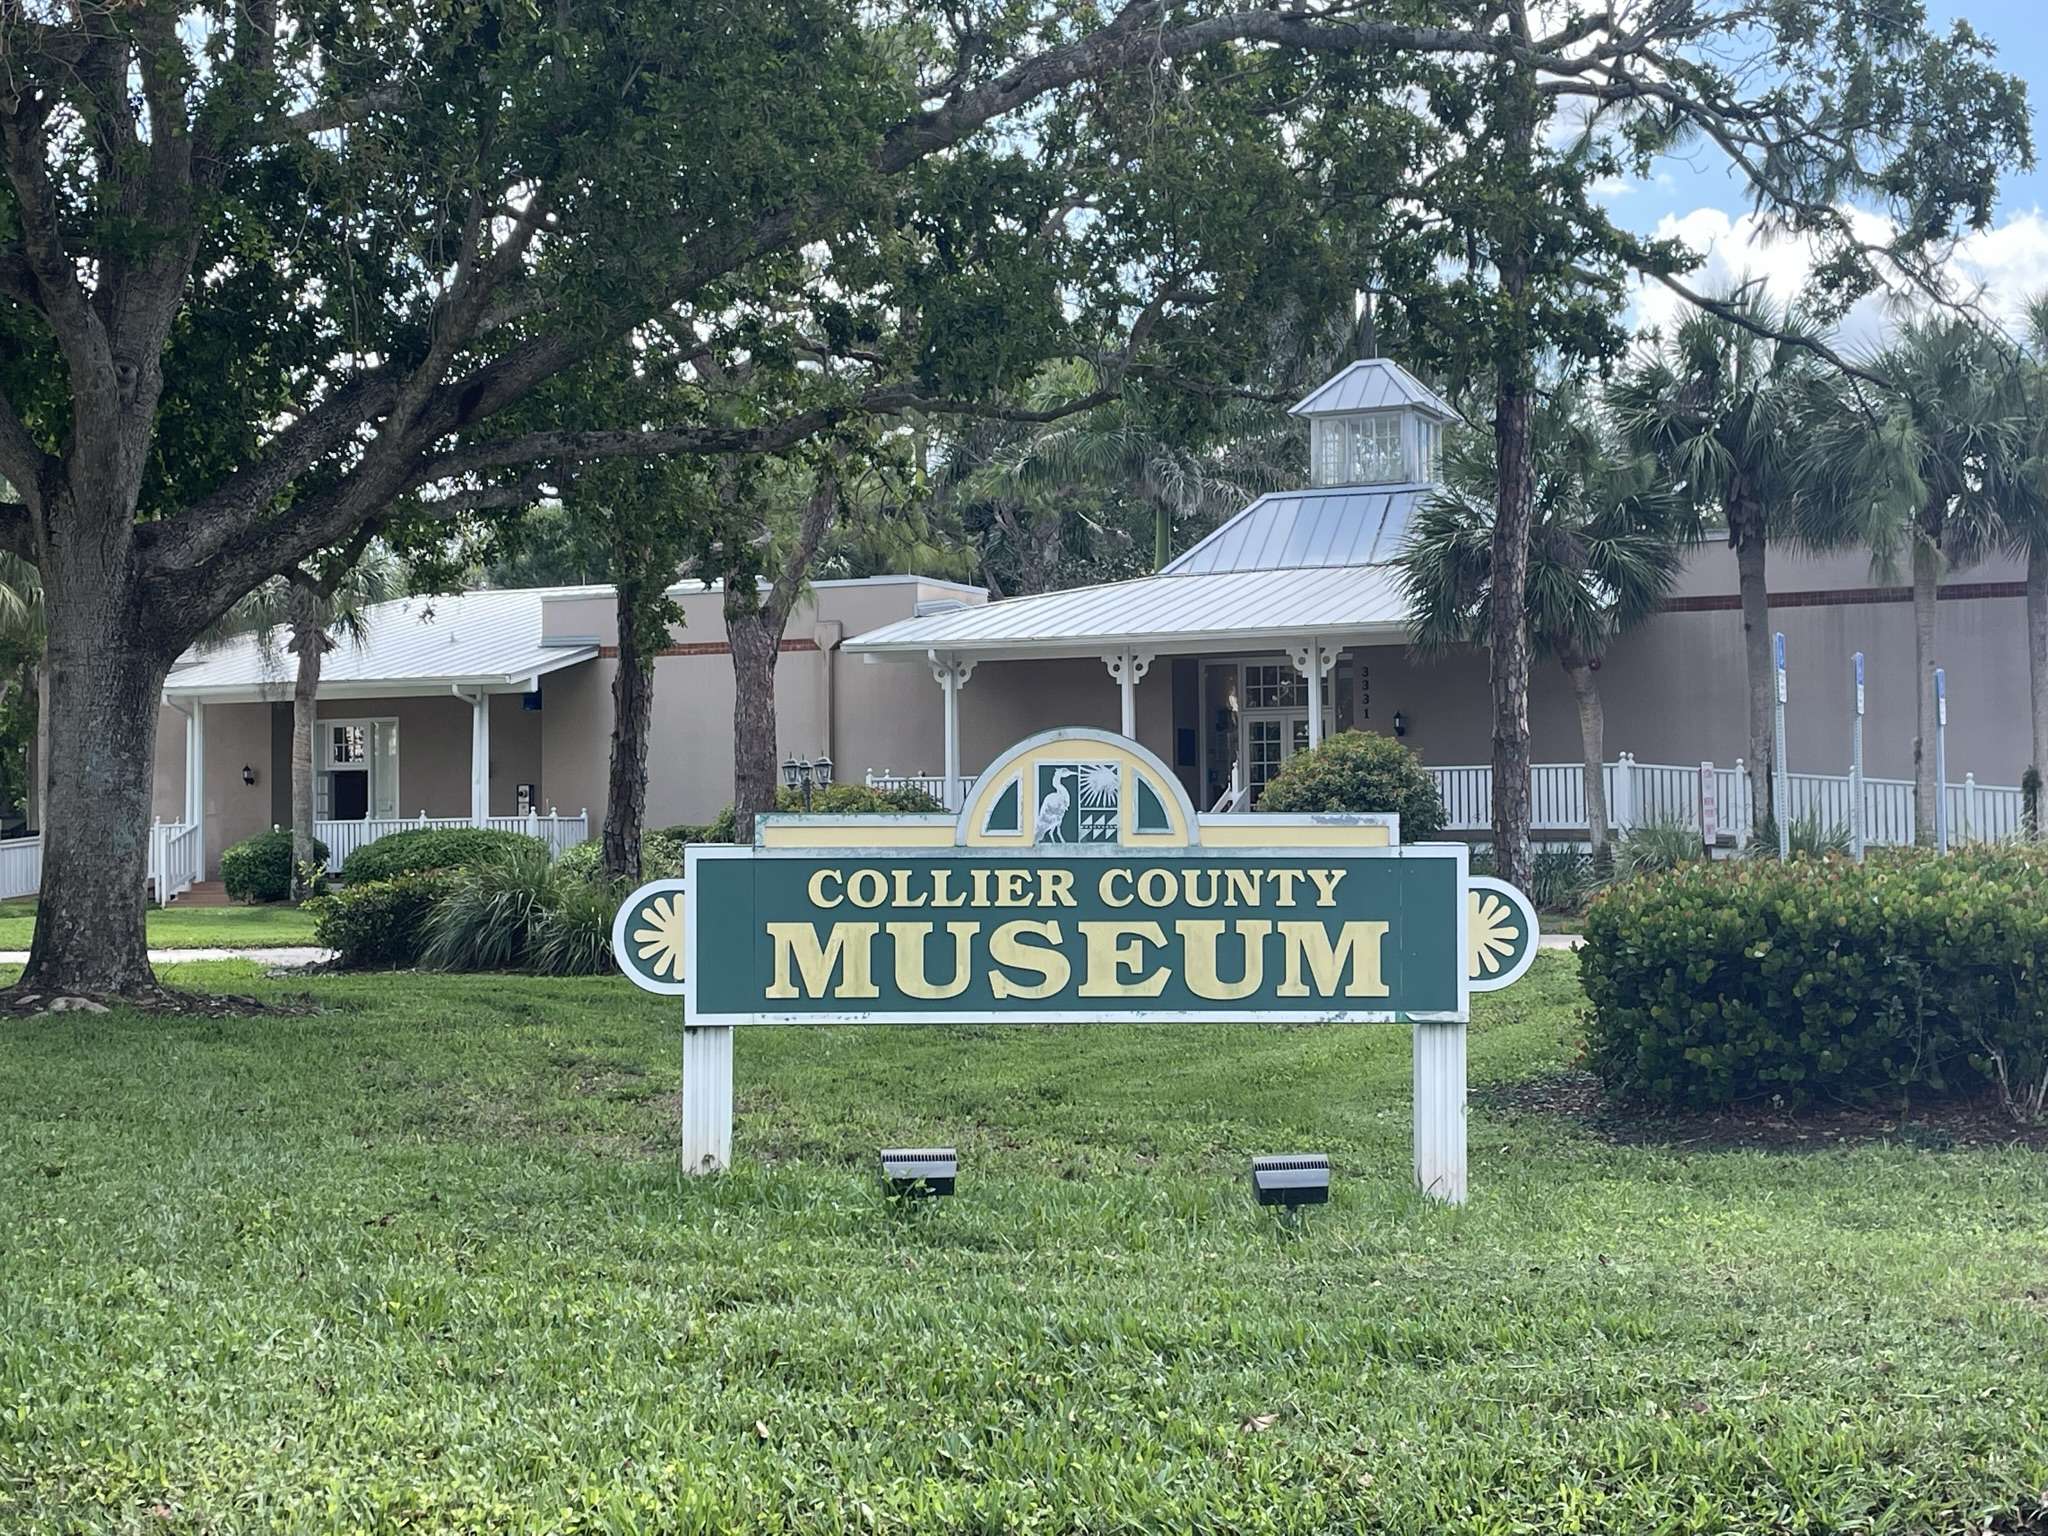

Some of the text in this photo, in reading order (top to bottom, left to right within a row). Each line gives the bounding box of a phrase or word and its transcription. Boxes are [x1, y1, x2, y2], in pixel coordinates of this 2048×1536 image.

[1361, 666, 1370, 719] 3331
[808, 868, 1348, 908] COLLIER COUNTY
[765, 919, 1391, 1000] MUSEUM
